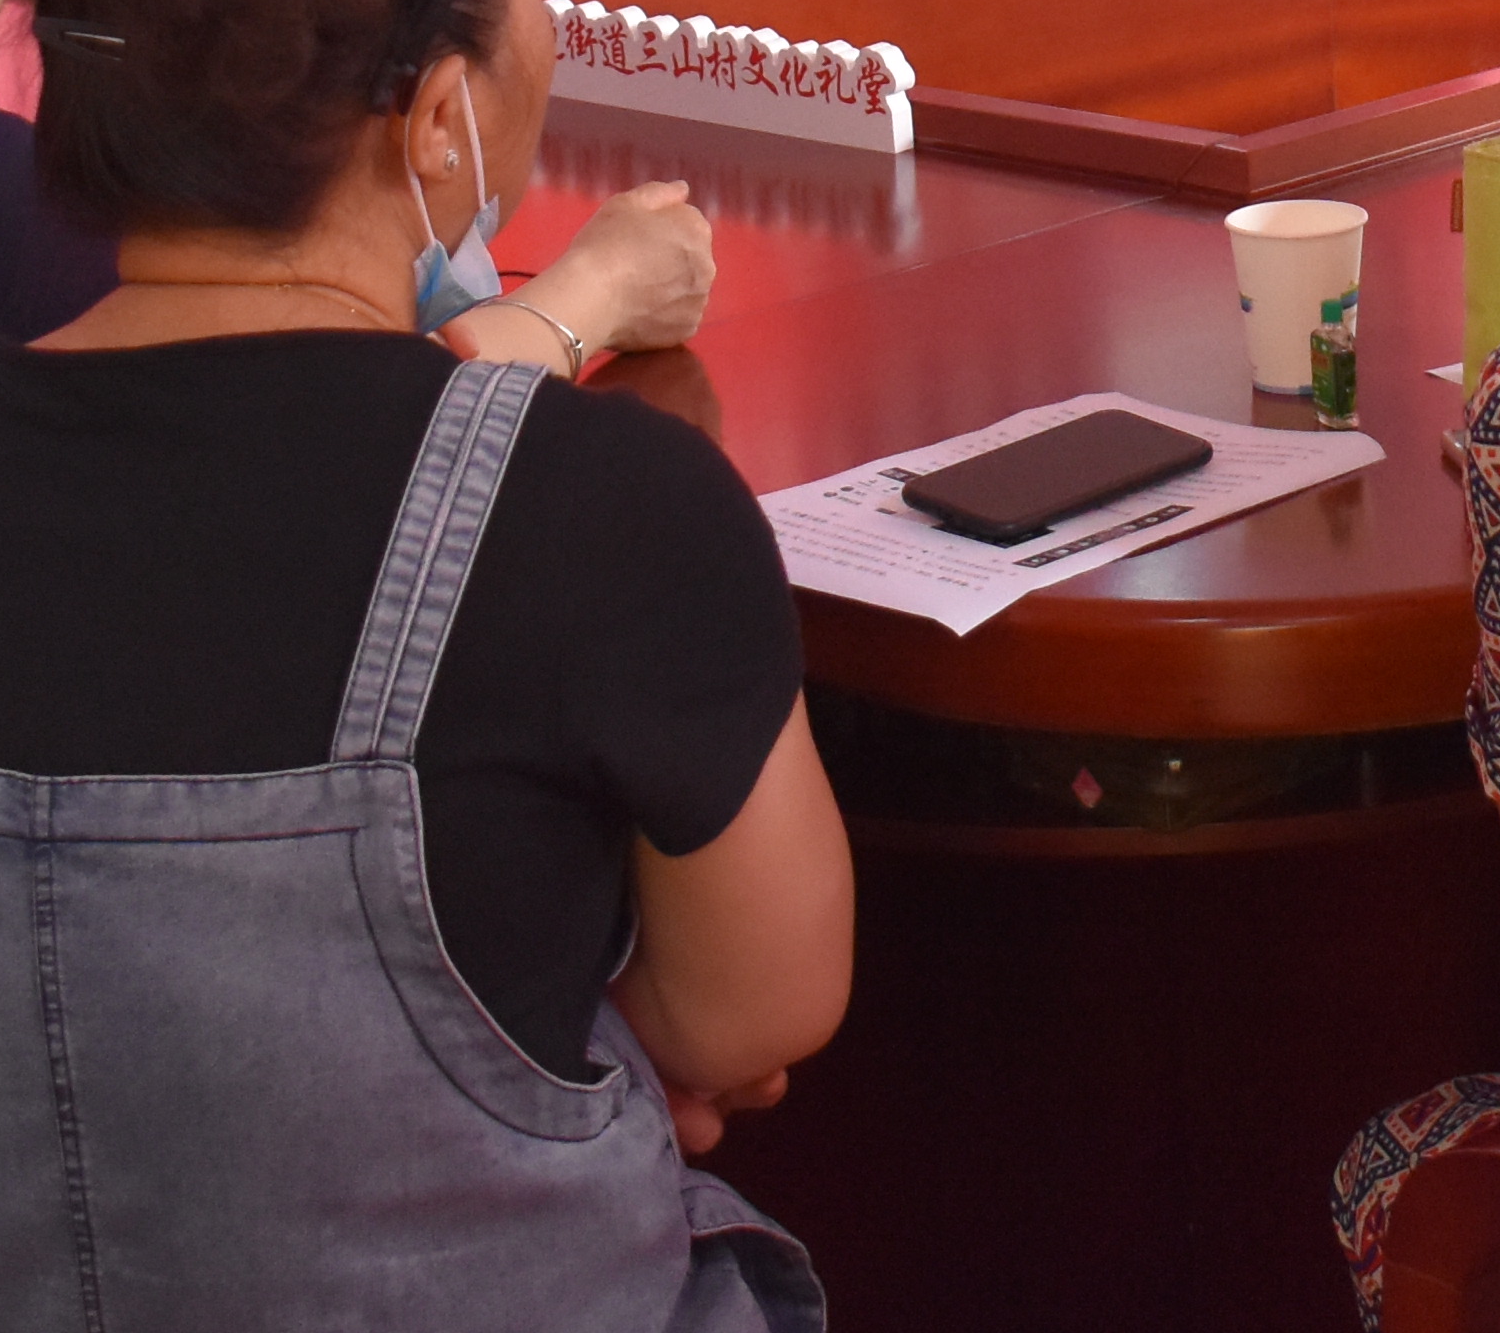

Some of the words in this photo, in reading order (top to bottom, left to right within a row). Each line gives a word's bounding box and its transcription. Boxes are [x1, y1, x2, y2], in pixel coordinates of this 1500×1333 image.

[553, 14, 892, 115] 街道三山村文化礼堂
